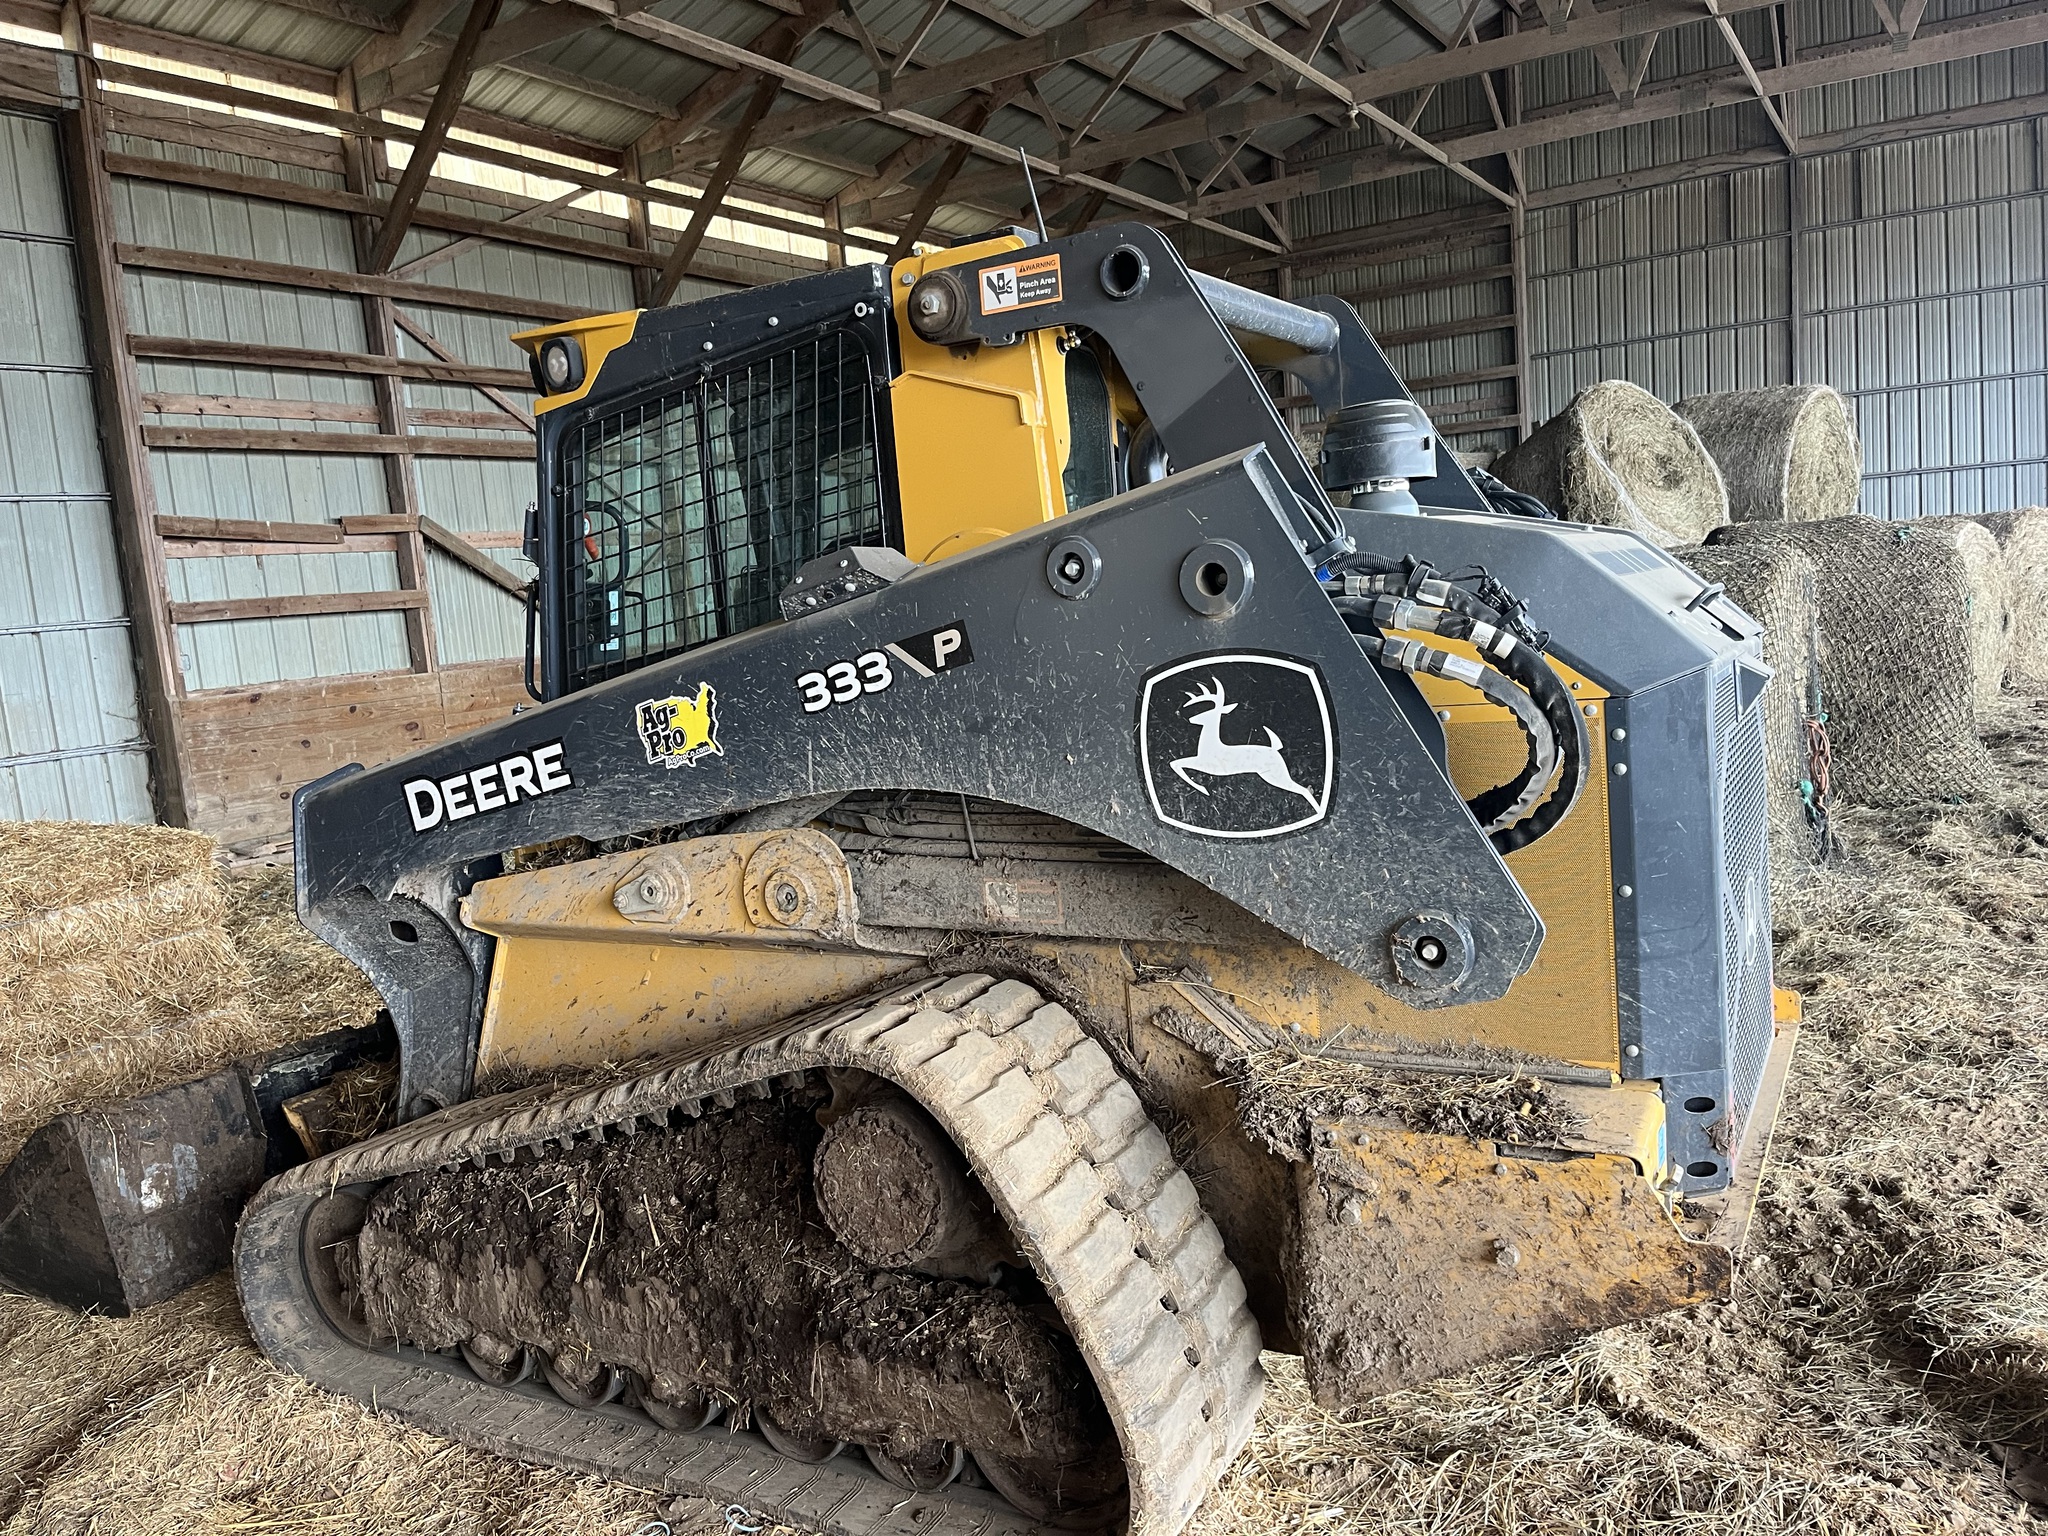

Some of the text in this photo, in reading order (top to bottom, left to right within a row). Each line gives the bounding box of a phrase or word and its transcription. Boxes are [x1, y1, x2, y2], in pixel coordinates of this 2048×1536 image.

[1025, 260, 1056, 271] WARNING
[1020, 277, 1056, 289] Pinch Area
[1035, 288, 1052, 296] Away
[797, 628, 962, 713] 333 P
[640, 703, 678, 734] Ag-
[645, 728, 687, 760] Pro
[668, 745, 710, 765] AgProCo.com
[403, 742, 572, 832] DEERE
